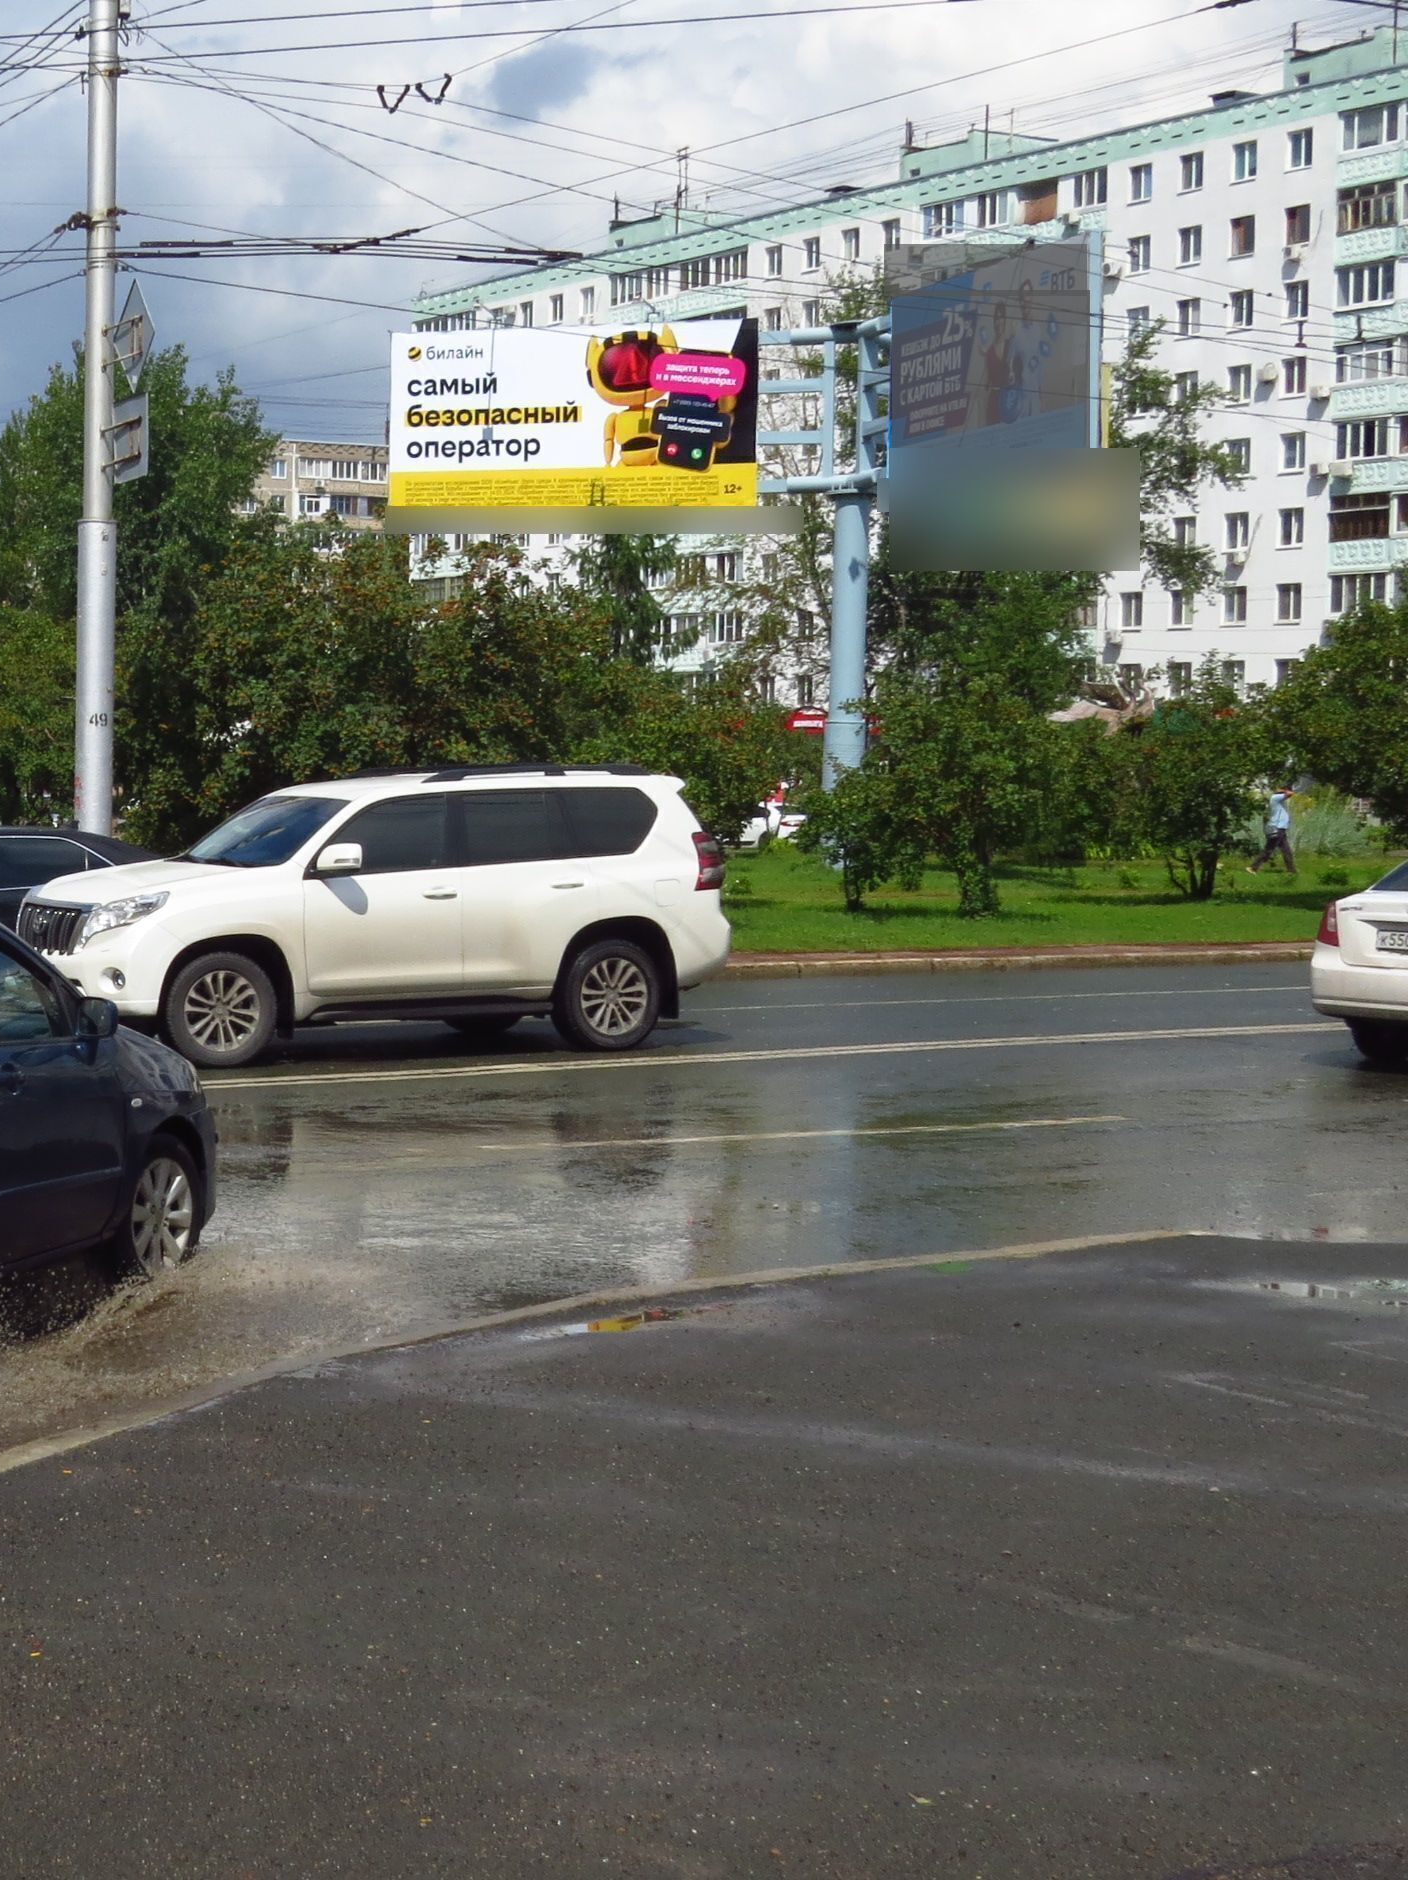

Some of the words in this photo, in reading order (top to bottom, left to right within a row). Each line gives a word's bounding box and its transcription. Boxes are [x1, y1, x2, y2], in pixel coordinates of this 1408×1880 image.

[425, 345, 484, 360] билайн
[900, 344, 962, 385] РУБЛЯМИ
[665, 364, 697, 373] защита
[699, 365, 730, 376] теперь
[407, 372, 498, 397] самый
[907, 376, 943, 405] КАРТОЙ
[407, 401, 580, 428] безопасный
[407, 434, 541, 463] оператор
[723, 484, 743, 494] 12+
[89, 713, 108, 727] 49
